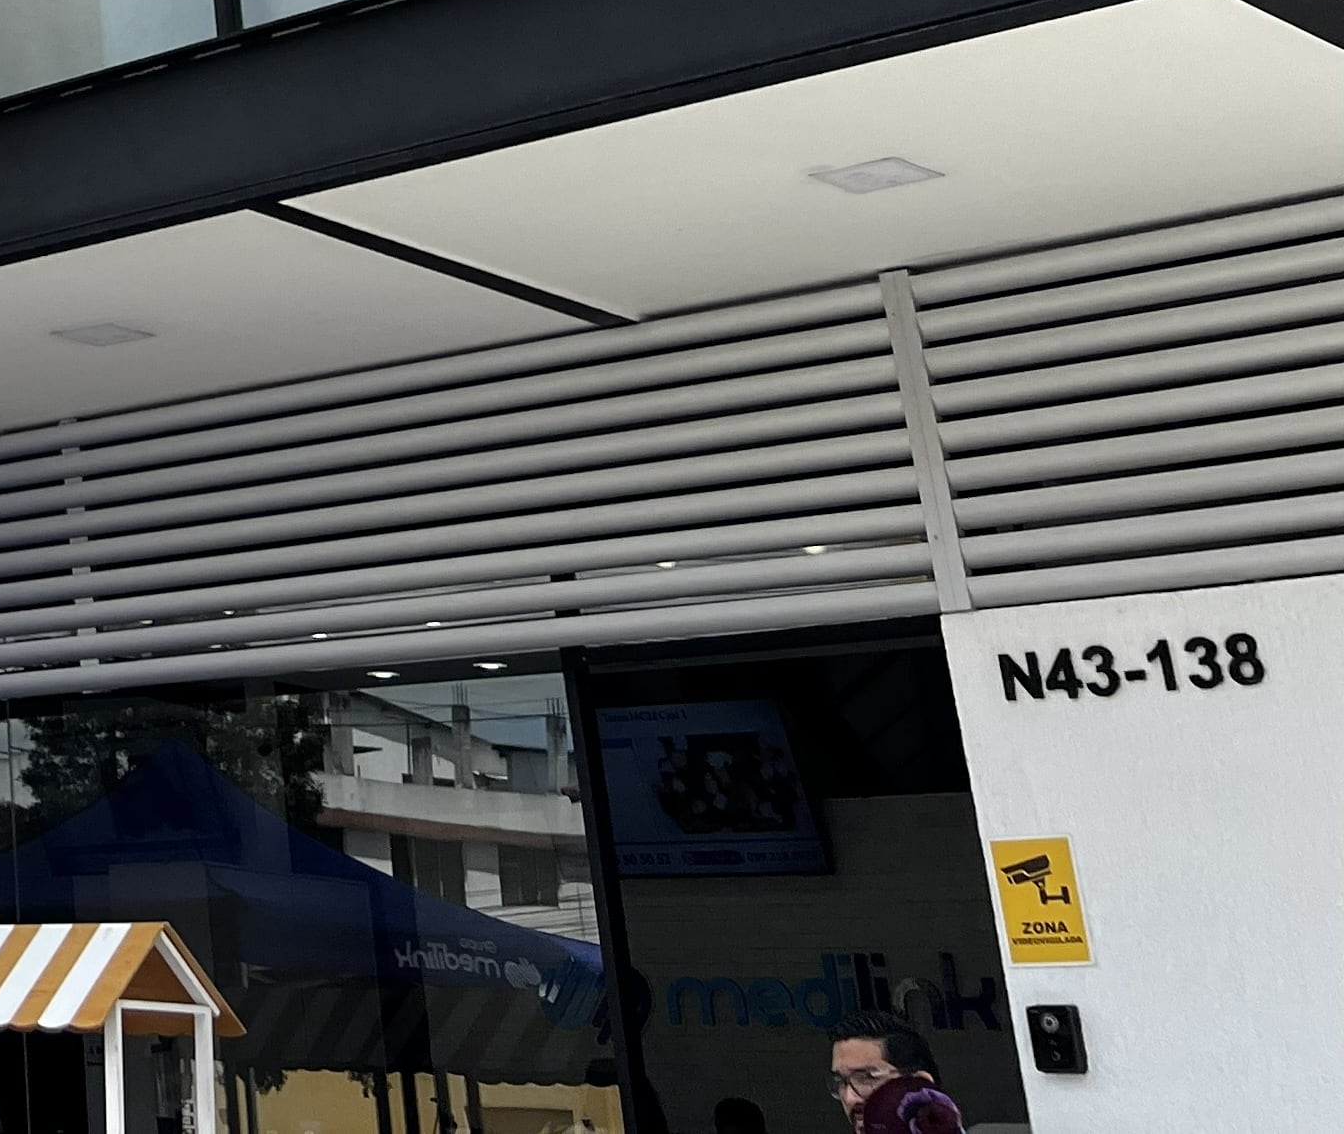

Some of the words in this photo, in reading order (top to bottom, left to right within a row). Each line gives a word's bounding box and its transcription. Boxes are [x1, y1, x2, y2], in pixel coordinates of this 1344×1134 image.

[997, 632, 1266, 702] N43-138
[1021, 921, 1068, 934] ZONA
[666, 952, 1000, 1031] medilink
